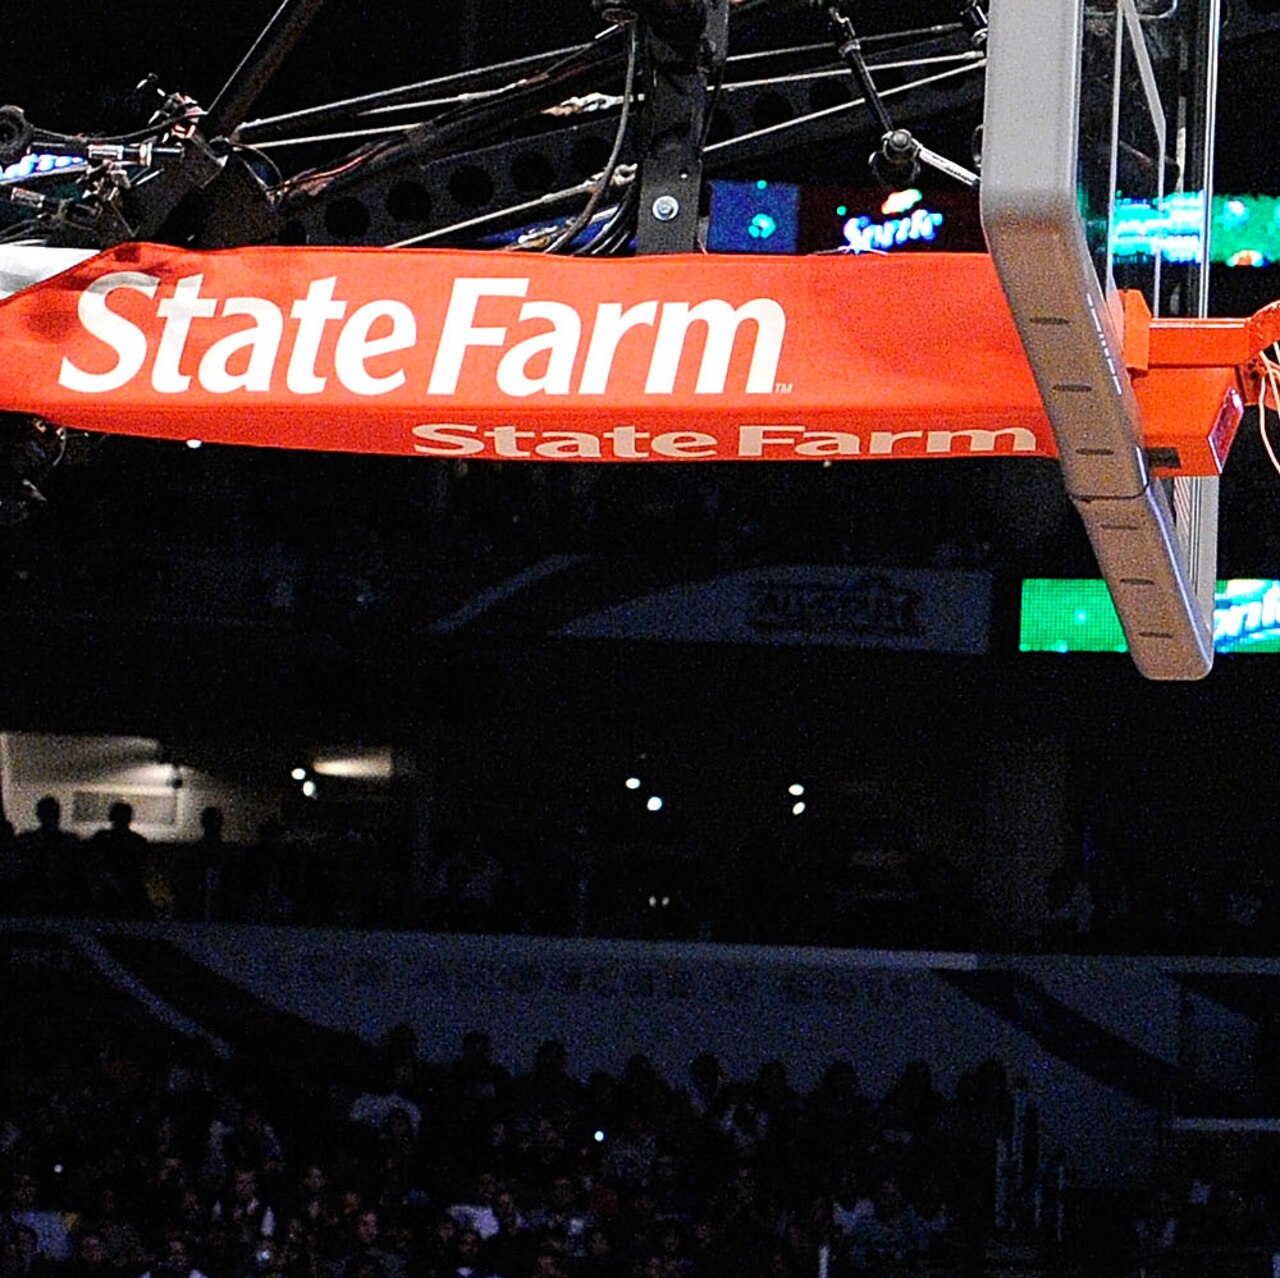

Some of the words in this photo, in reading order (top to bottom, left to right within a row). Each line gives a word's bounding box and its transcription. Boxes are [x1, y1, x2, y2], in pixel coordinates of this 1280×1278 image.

[58, 271, 417, 396] State
[426, 276, 786, 397] Farm
[411, 423, 718, 459] State
[737, 425, 1037, 459] Farm
